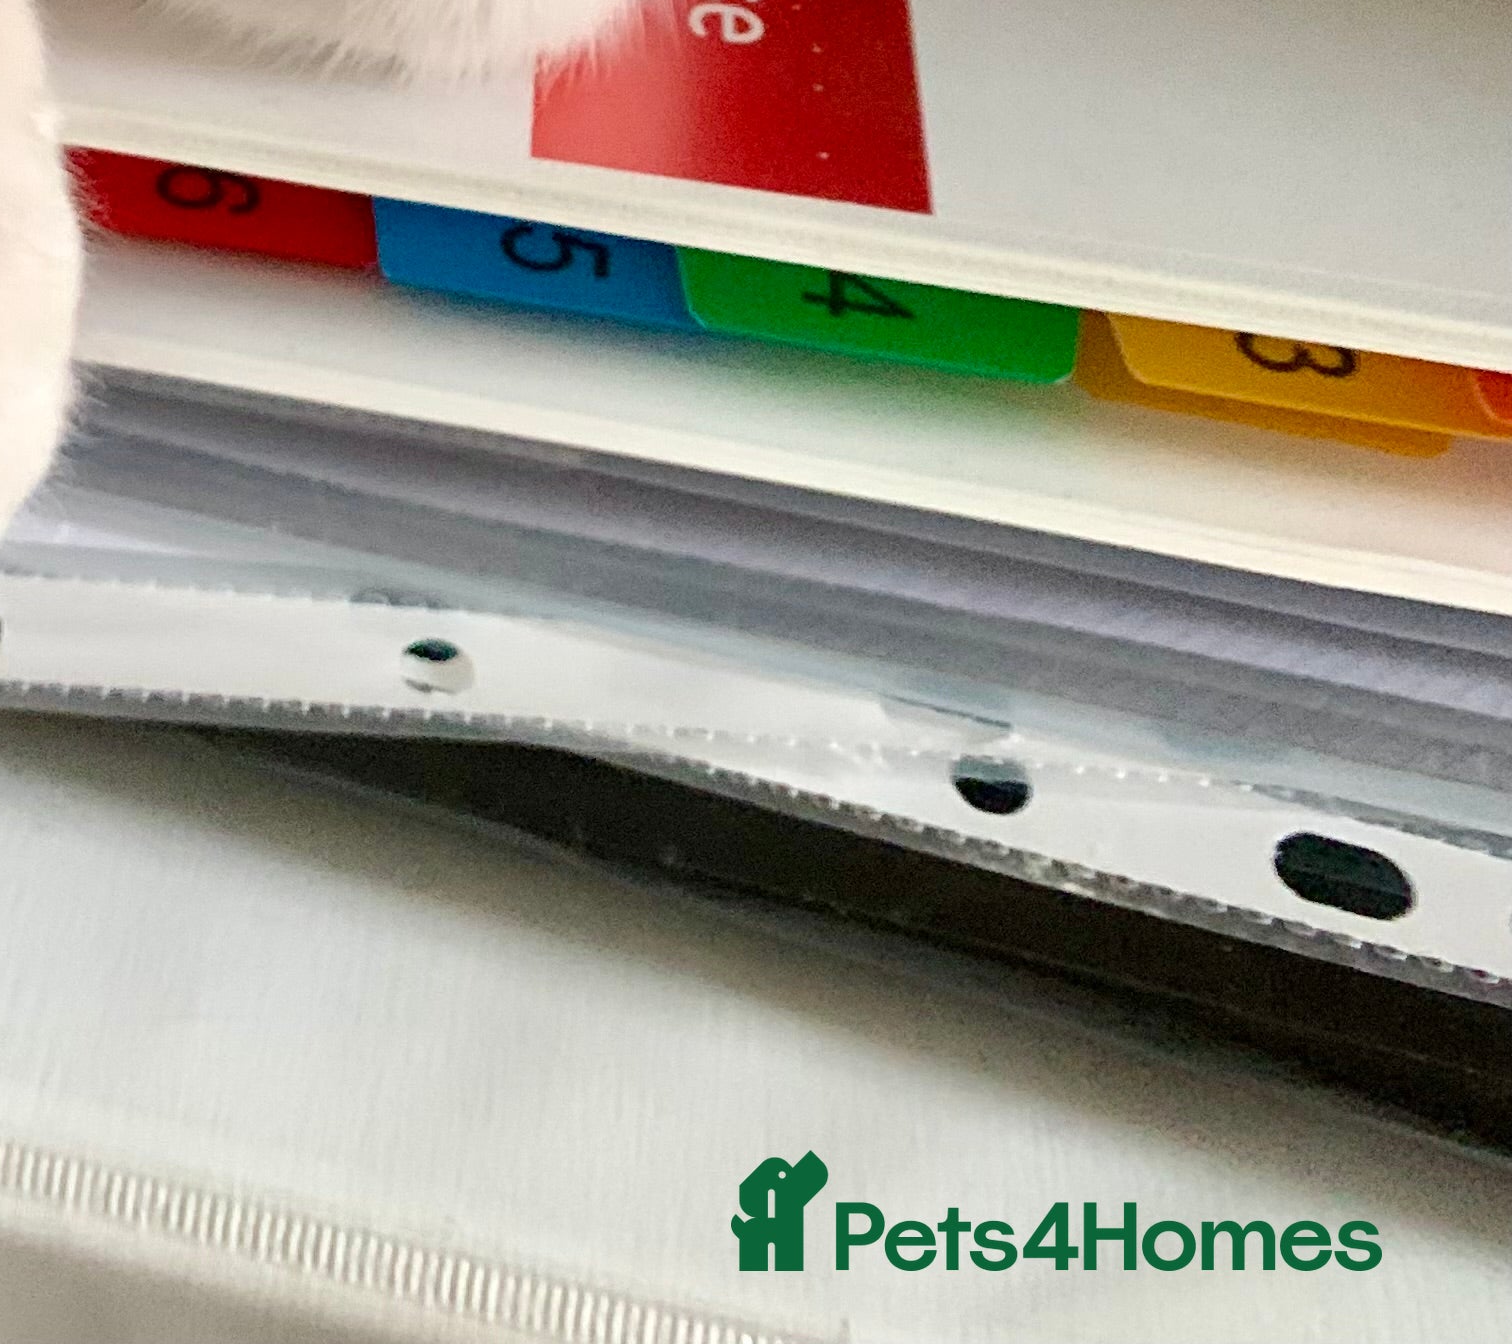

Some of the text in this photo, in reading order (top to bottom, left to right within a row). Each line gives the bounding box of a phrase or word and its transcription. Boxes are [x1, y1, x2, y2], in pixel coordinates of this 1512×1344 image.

[155, 162, 262, 214] 6
[500, 221, 610, 279] 5
[801, 269, 916, 321] 4
[1233, 331, 1362, 378] 3
